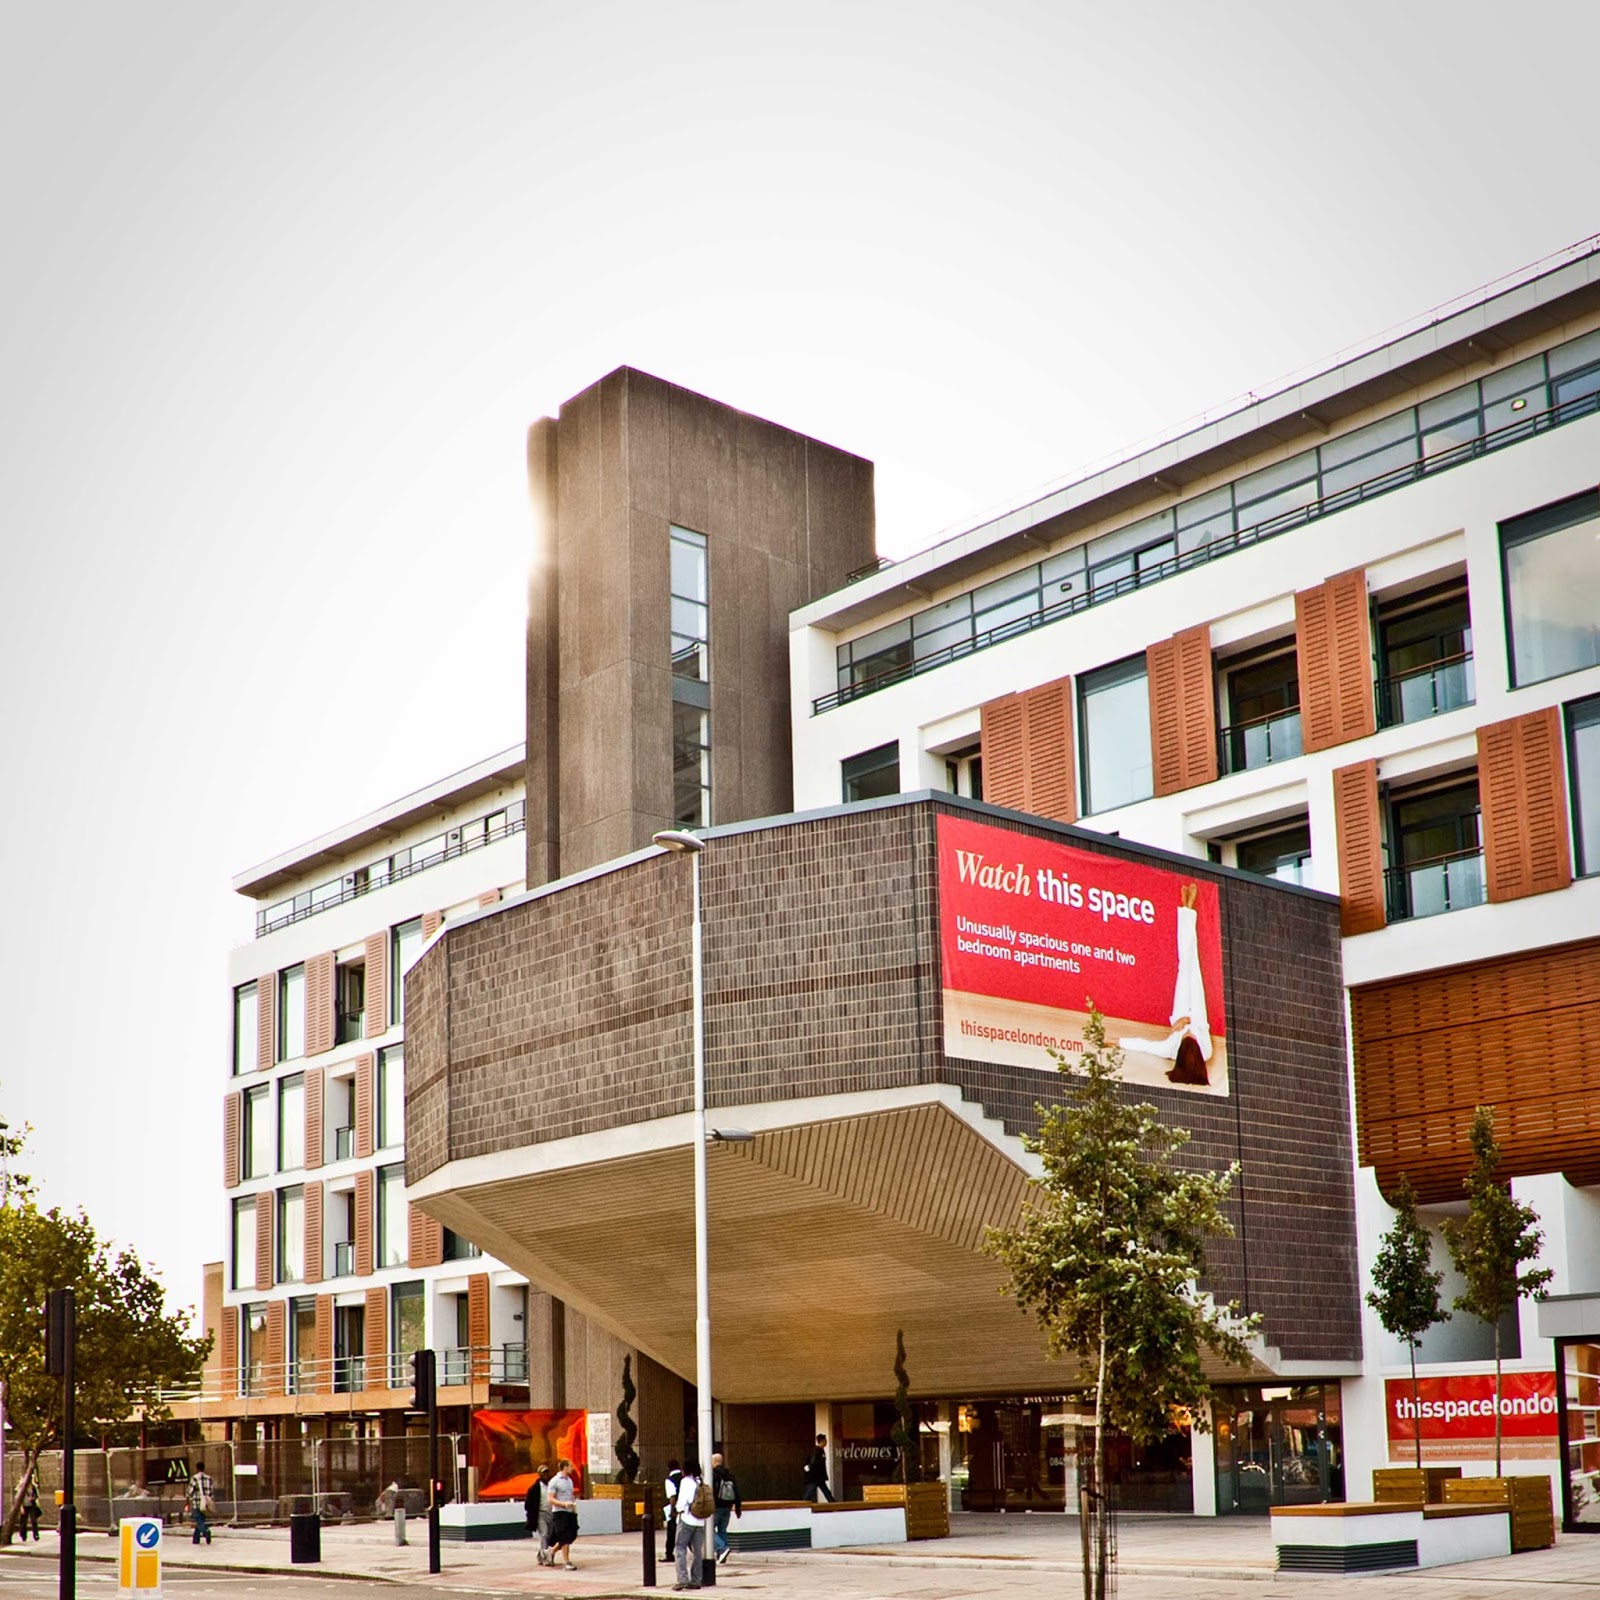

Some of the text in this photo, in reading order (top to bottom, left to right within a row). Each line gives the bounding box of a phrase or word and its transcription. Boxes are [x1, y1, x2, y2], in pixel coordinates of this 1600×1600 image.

[955, 849, 1155, 924] Watch this space
[957, 915, 1136, 966] Unusually spacious one and two
[957, 935, 1080, 973] bedroom apartments
[961, 1019, 1084, 1052] thisspacelondon.com
[835, 1442, 892, 1459] welcomes
